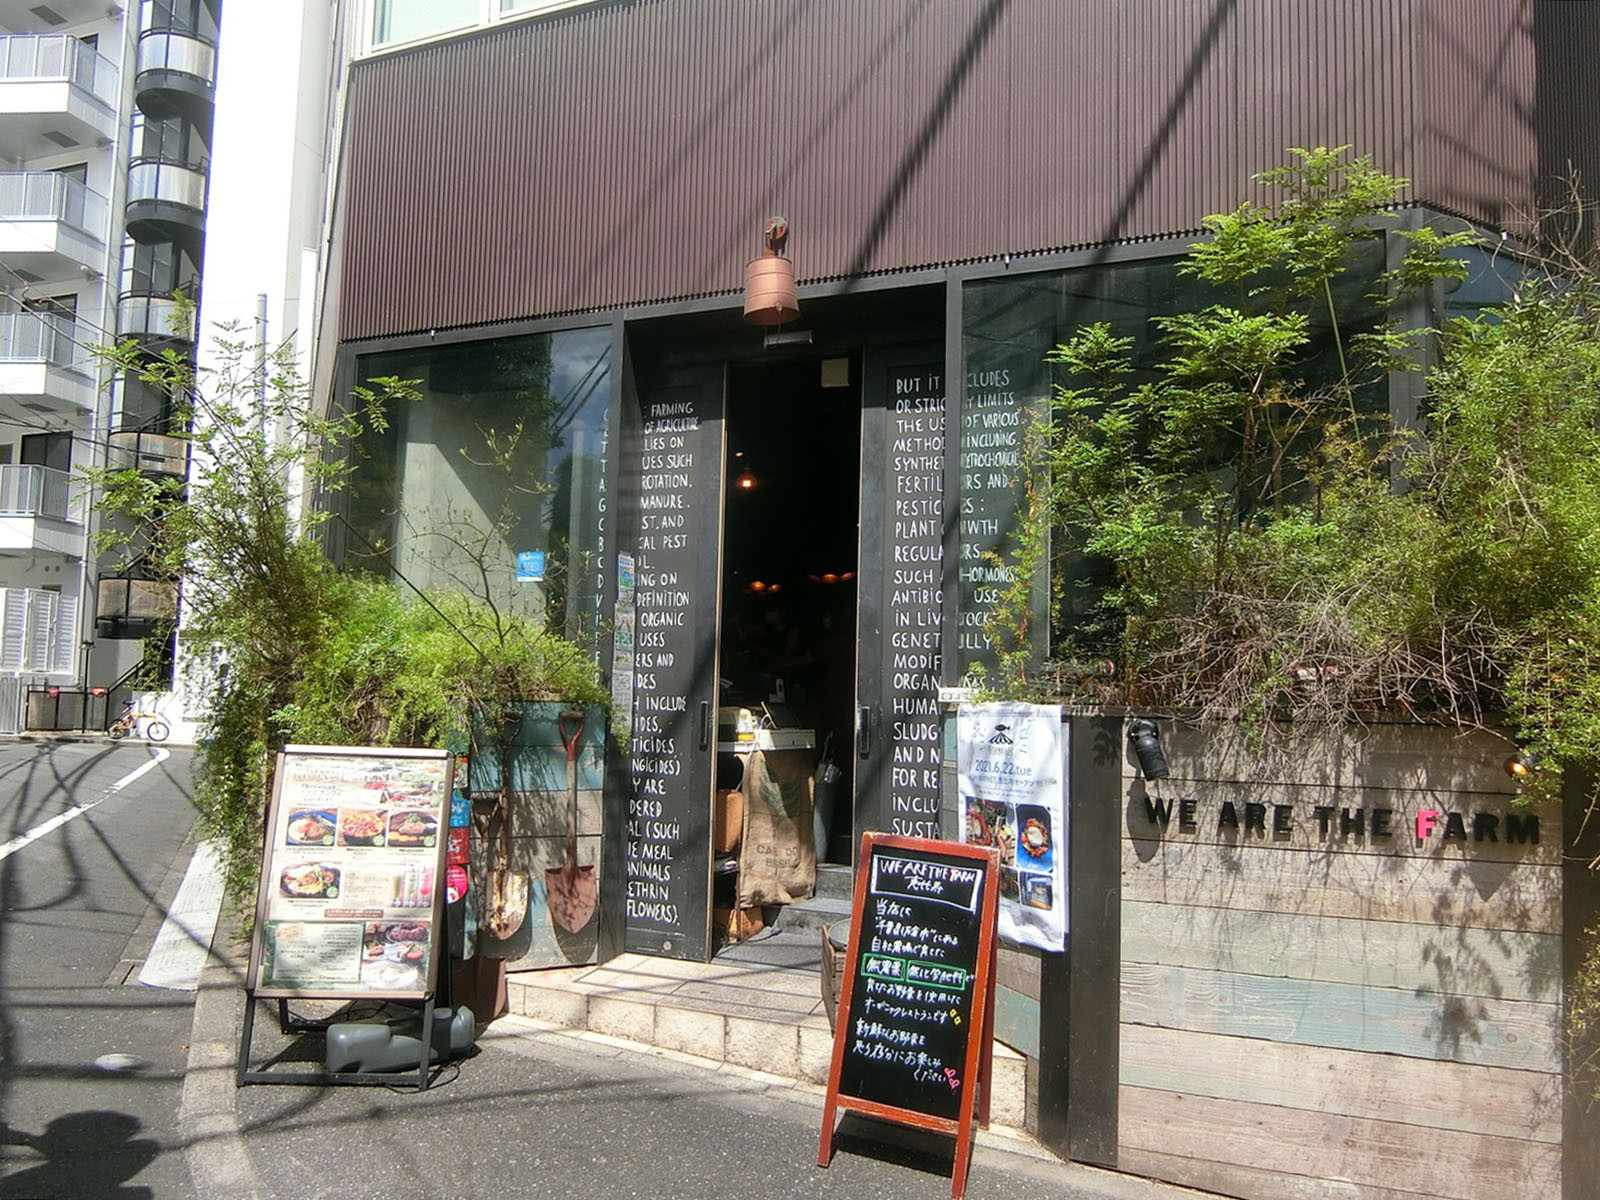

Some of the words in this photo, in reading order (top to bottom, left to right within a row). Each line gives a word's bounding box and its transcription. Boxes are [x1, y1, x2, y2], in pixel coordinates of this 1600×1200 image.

[896, 378, 920, 394] BUT
[928, 373, 940, 391] IT
[896, 398, 911, 414] OR
[977, 391, 1015, 408] LIMITS
[650, 400, 694, 418] FARMING
[644, 420, 655, 435] OF
[896, 418, 923, 433] THE
[982, 410, 1020, 428] VARIOUS
[643, 437, 666, 451] LIES
[670, 435, 684, 449] ON
[666, 453, 693, 469] SUCH
[987, 472, 1008, 489] AND
[661, 514, 685, 530] AND
[895, 520, 936, 538] PLANT
[961, 519, 998, 536] WTH
[662, 534, 687, 549] PEST
[660, 571, 678, 586] ON
[894, 569, 933, 584] SUCH
[973, 589, 1000, 604] USE
[640, 607, 685, 627] ORGANIC
[895, 608, 910, 627] IN
[639, 631, 665, 647] USES
[656, 652, 674, 667] AND
[893, 722, 941, 741] SLUDG
[893, 745, 925, 763] AND
[892, 766, 917, 788] FOR
[644, 778, 667, 795] ARE
[1144, 798, 1197, 828] WE
[1219, 801, 1293, 832] ARE
[1314, 806, 1393, 838] THE
[1416, 809, 1540, 845] FARM
[642, 843, 673, 860] MEAL
[880, 859, 903, 875] WE
[902, 862, 929, 877] ARE
[928, 865, 949, 880] THE
[949, 867, 976, 883] FARM
